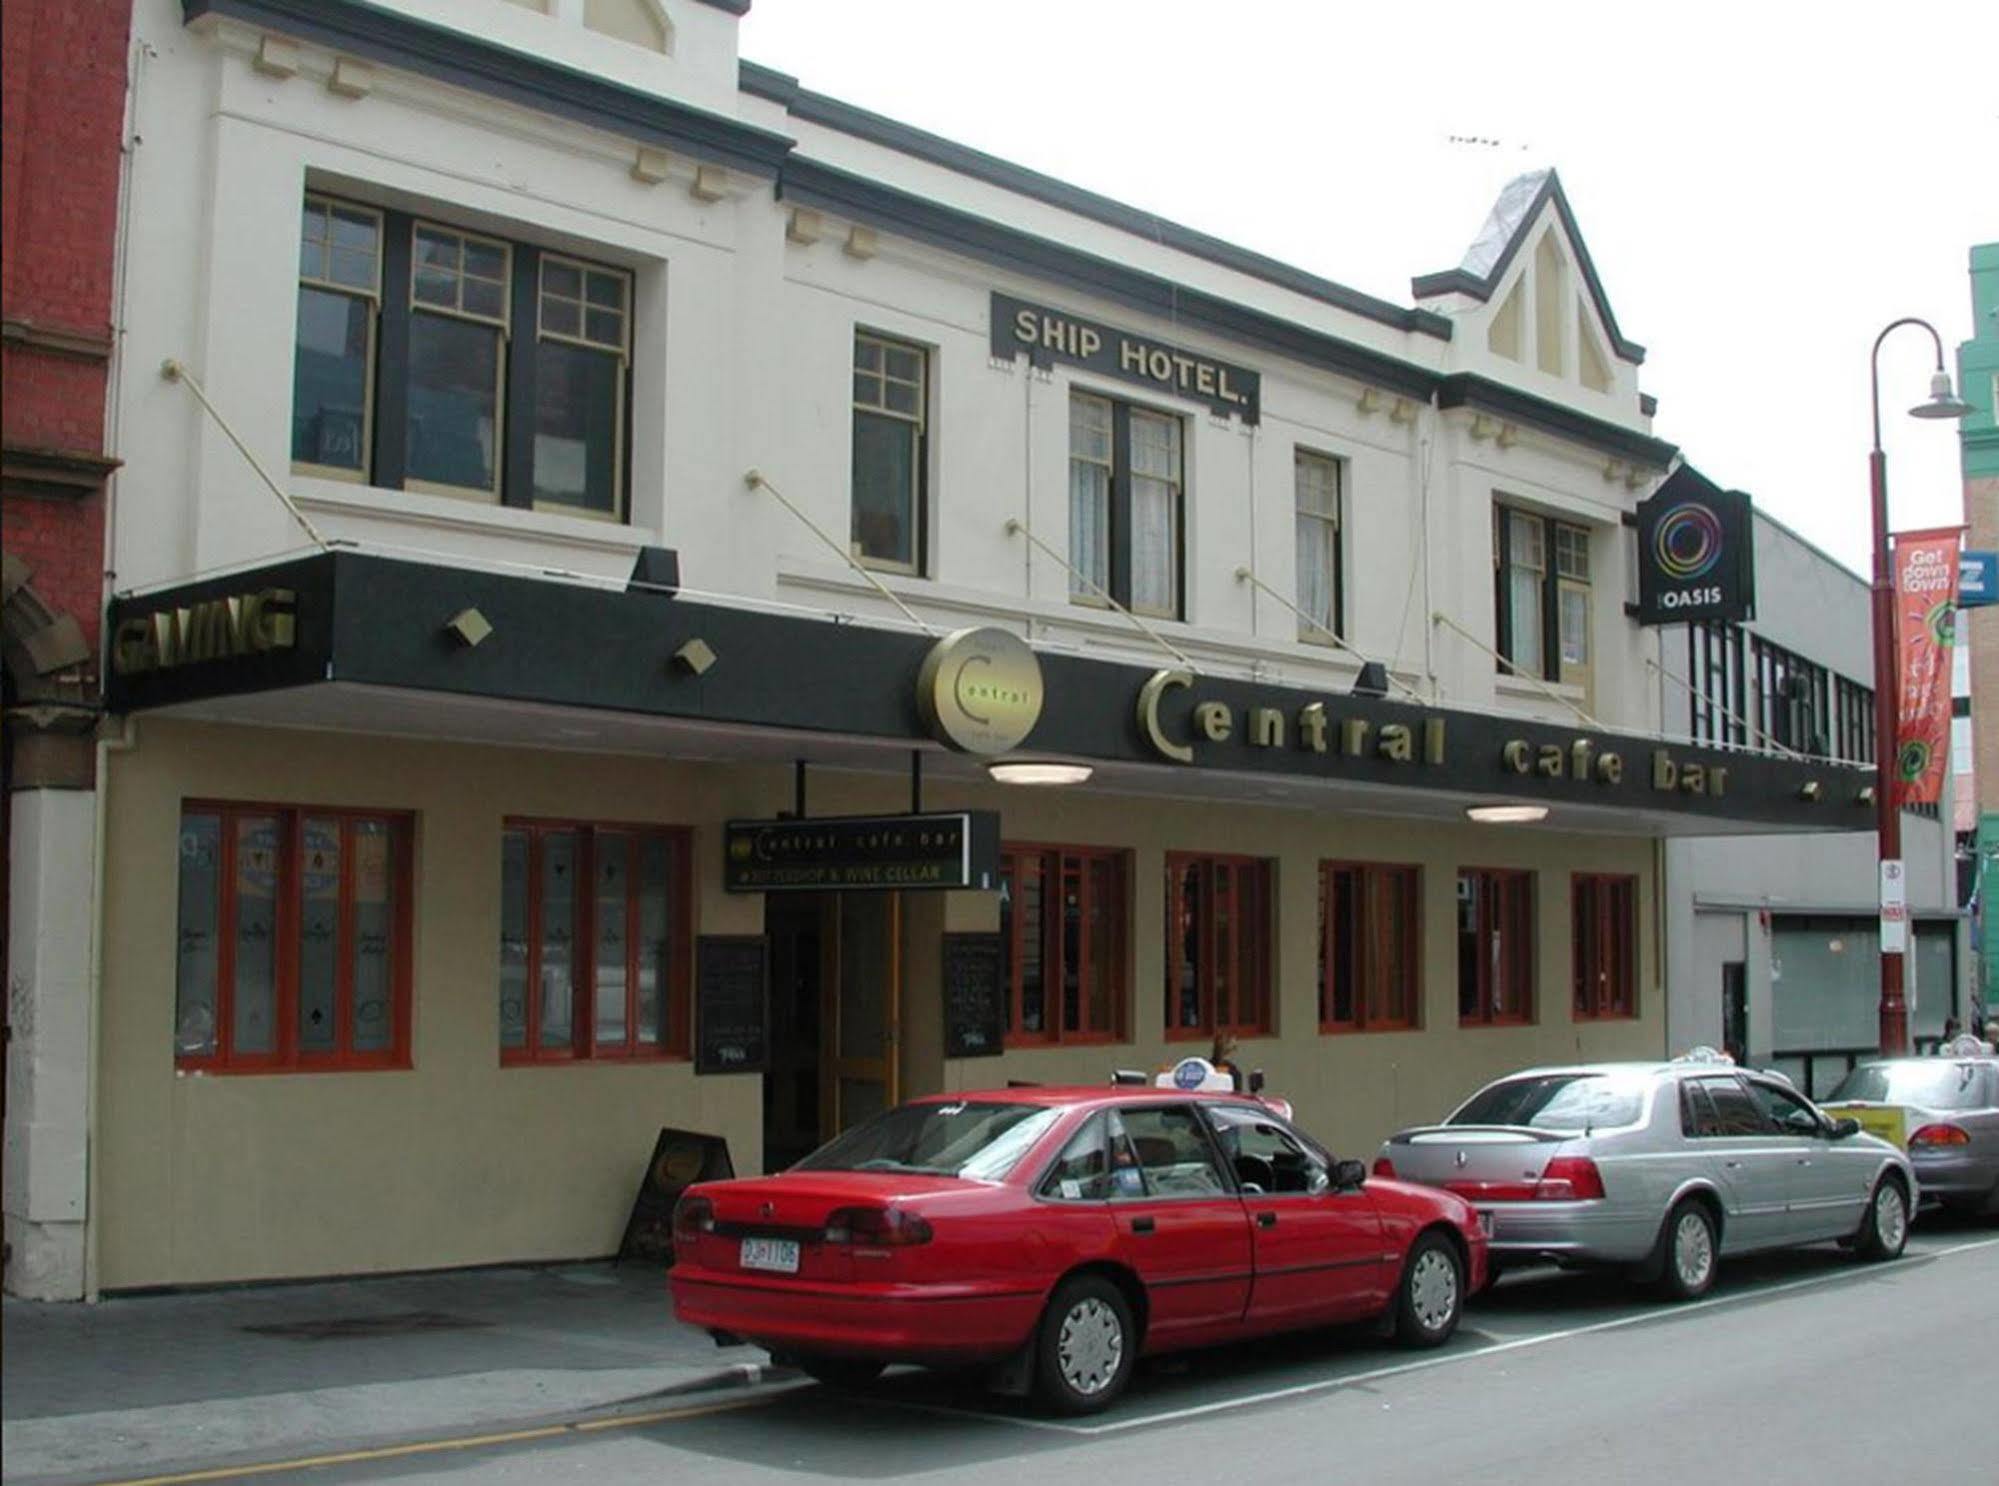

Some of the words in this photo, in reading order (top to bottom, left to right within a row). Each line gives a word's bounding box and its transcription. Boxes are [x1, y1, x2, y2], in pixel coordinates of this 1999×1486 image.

[1015, 310, 1101, 358] SHIP
[1121, 340, 1248, 404] HOTEL.
[1664, 586, 1722, 608] OASIS
[954, 655, 1028, 725] Central
[1137, 669, 1446, 765] Central
[1504, 738, 1623, 785] cafe
[1653, 750, 1729, 797] bar
